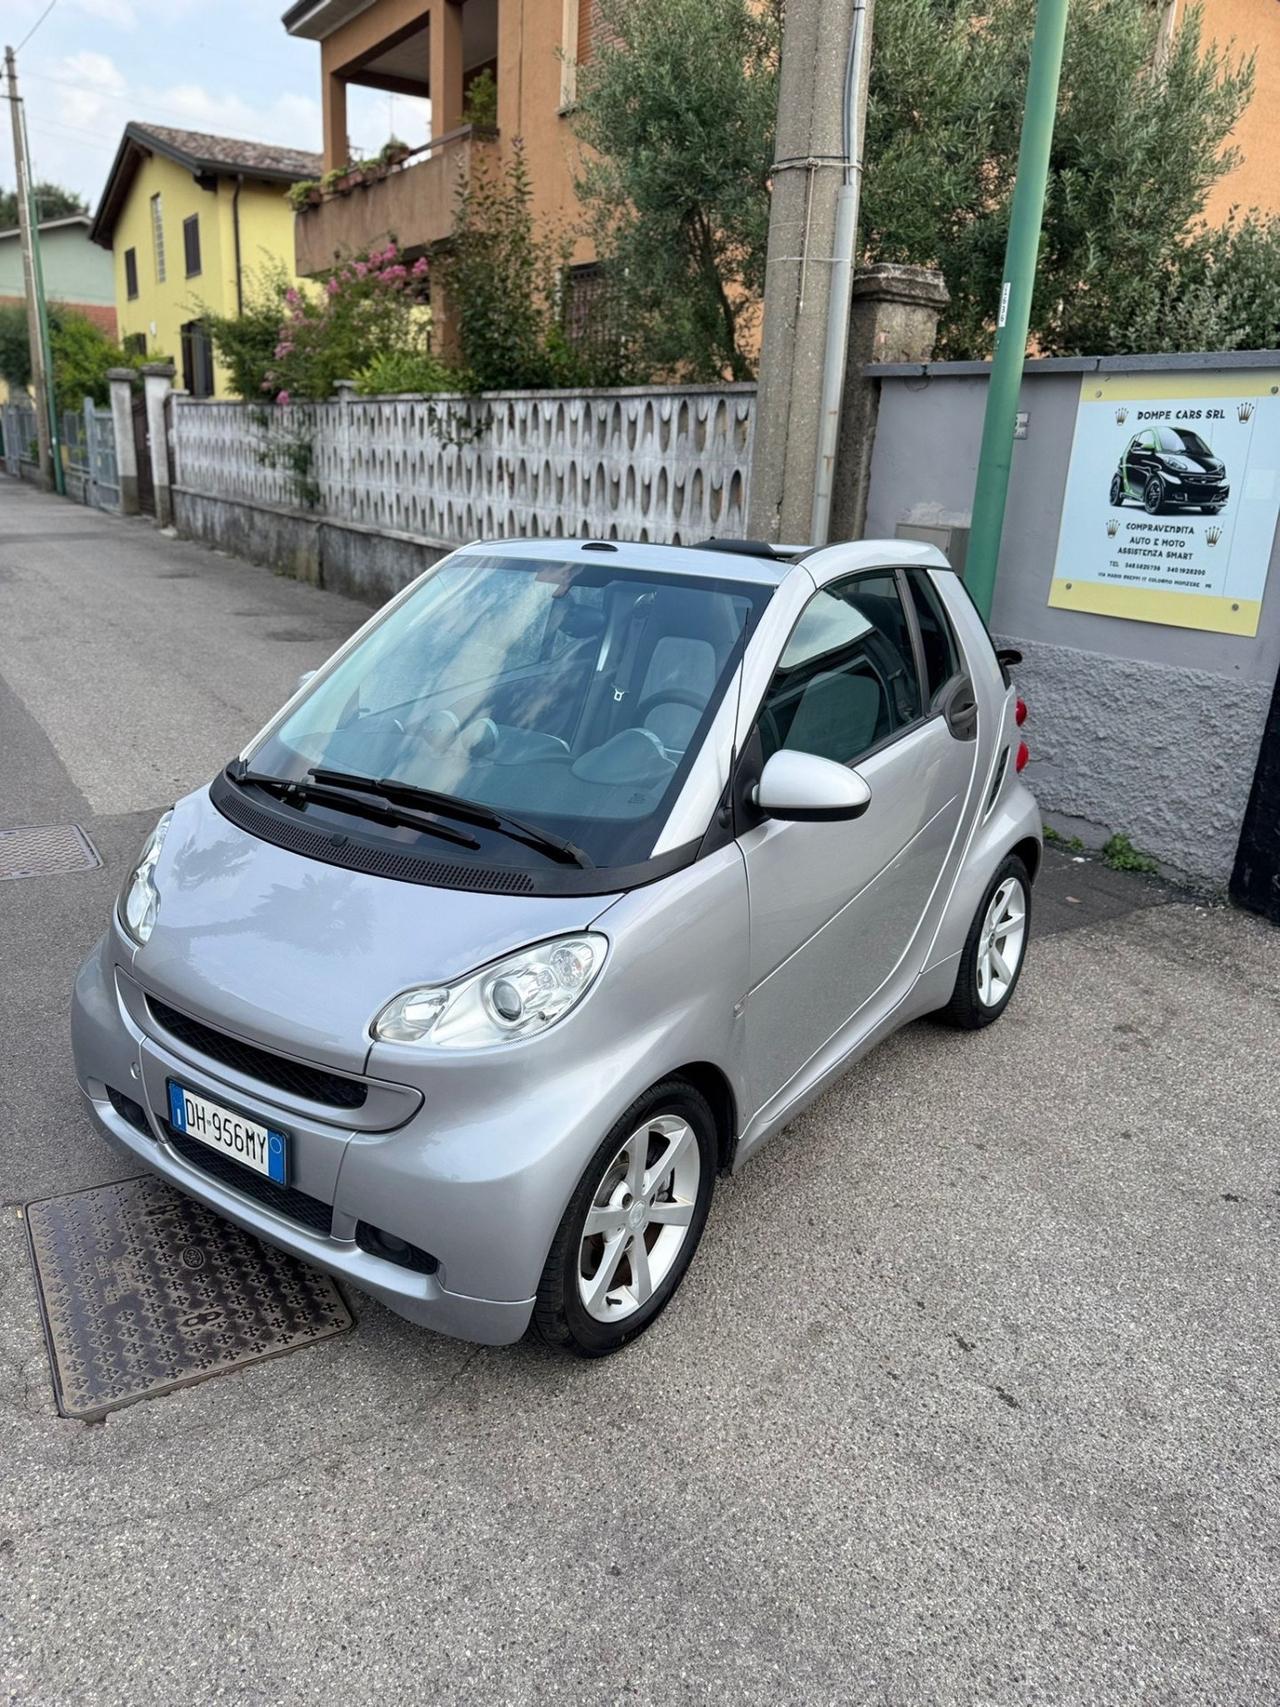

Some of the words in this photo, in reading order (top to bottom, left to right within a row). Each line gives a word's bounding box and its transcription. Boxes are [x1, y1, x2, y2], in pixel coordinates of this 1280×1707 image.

[1137, 410, 1171, 420] DOMPE
[1175, 410, 1202, 419] CARS
[1205, 409, 1225, 419] SRL
[1126, 522, 1195, 535] COMPRAVENDITA
[1129, 536, 1151, 546] AUTO
[1153, 538, 1160, 546] E
[1161, 539, 1186, 548] MOTO
[1118, 547, 1163, 558] ASSISTENZA
[1165, 551, 1193, 560] SMART
[1110, 560, 1119, 568] TEL
